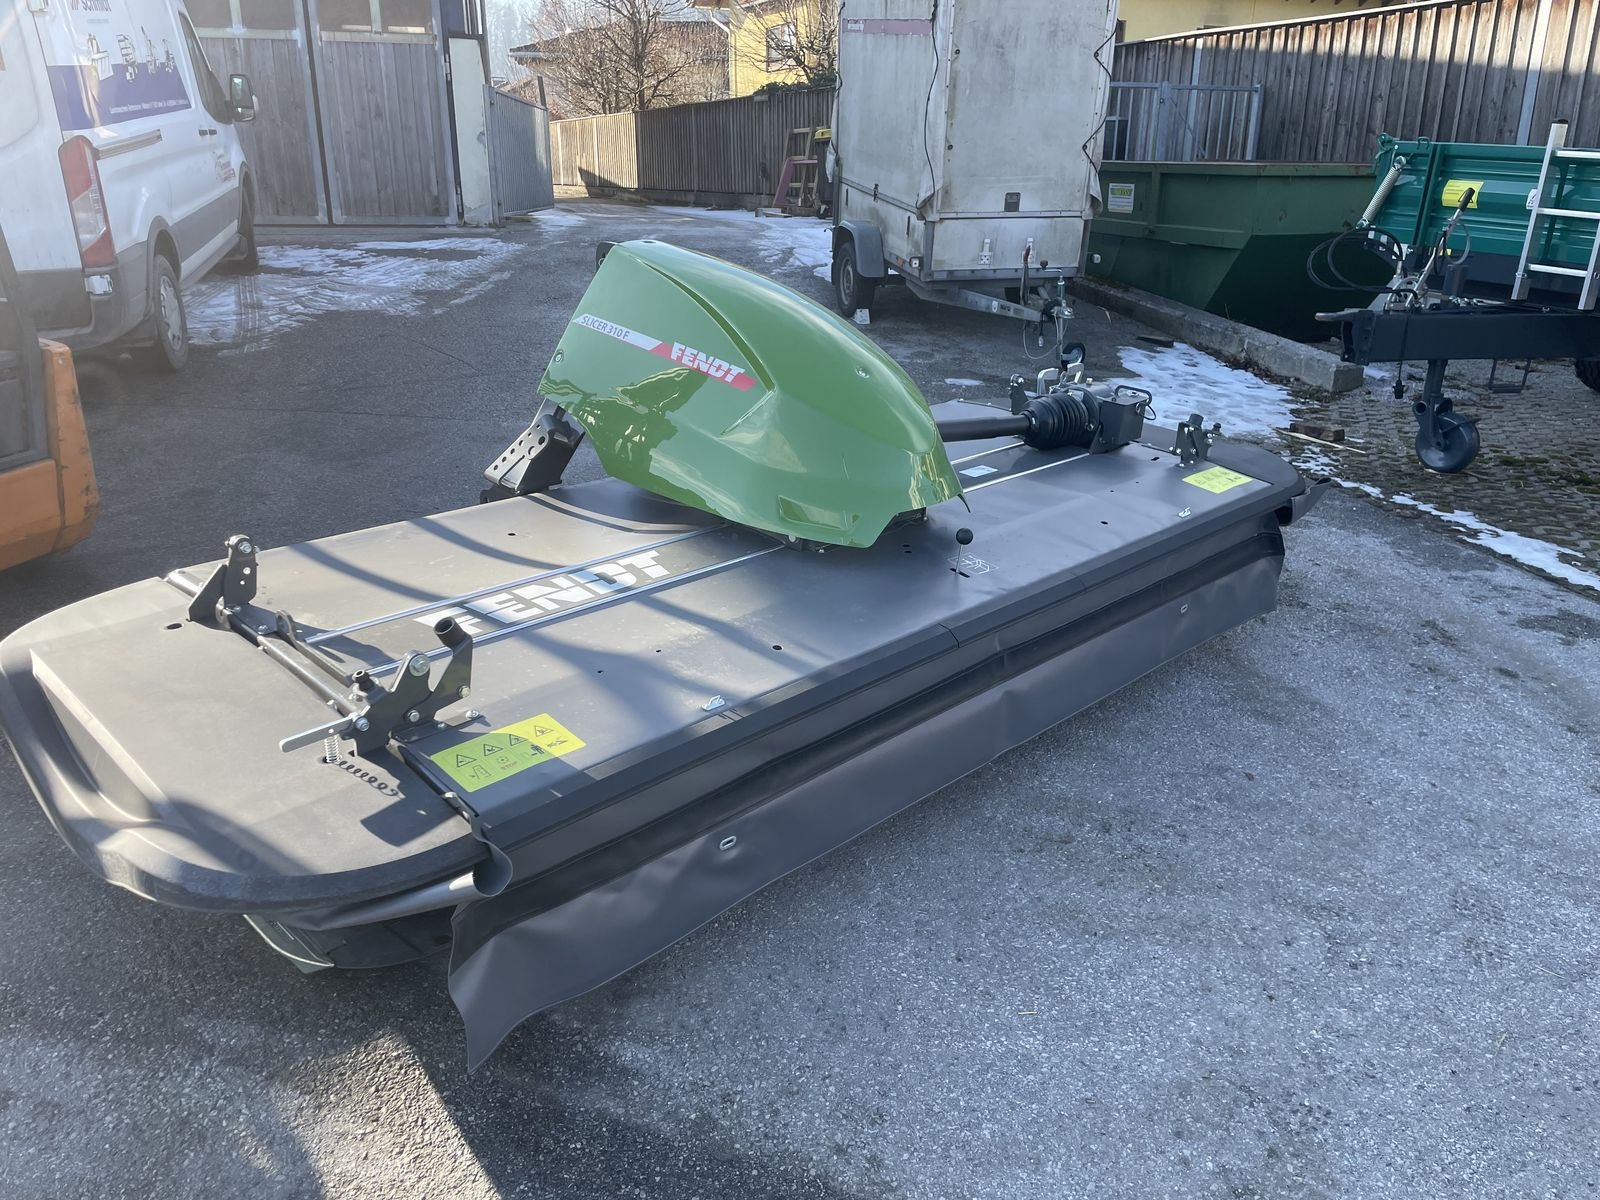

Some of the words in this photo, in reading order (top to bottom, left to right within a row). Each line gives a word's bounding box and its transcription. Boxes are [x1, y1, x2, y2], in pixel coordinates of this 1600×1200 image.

[581, 315, 608, 332] SLICER
[607, 325, 623, 338] 310
[622, 330, 631, 340] F
[670, 341, 746, 383] FENDT
[411, 550, 671, 635] FENDT
